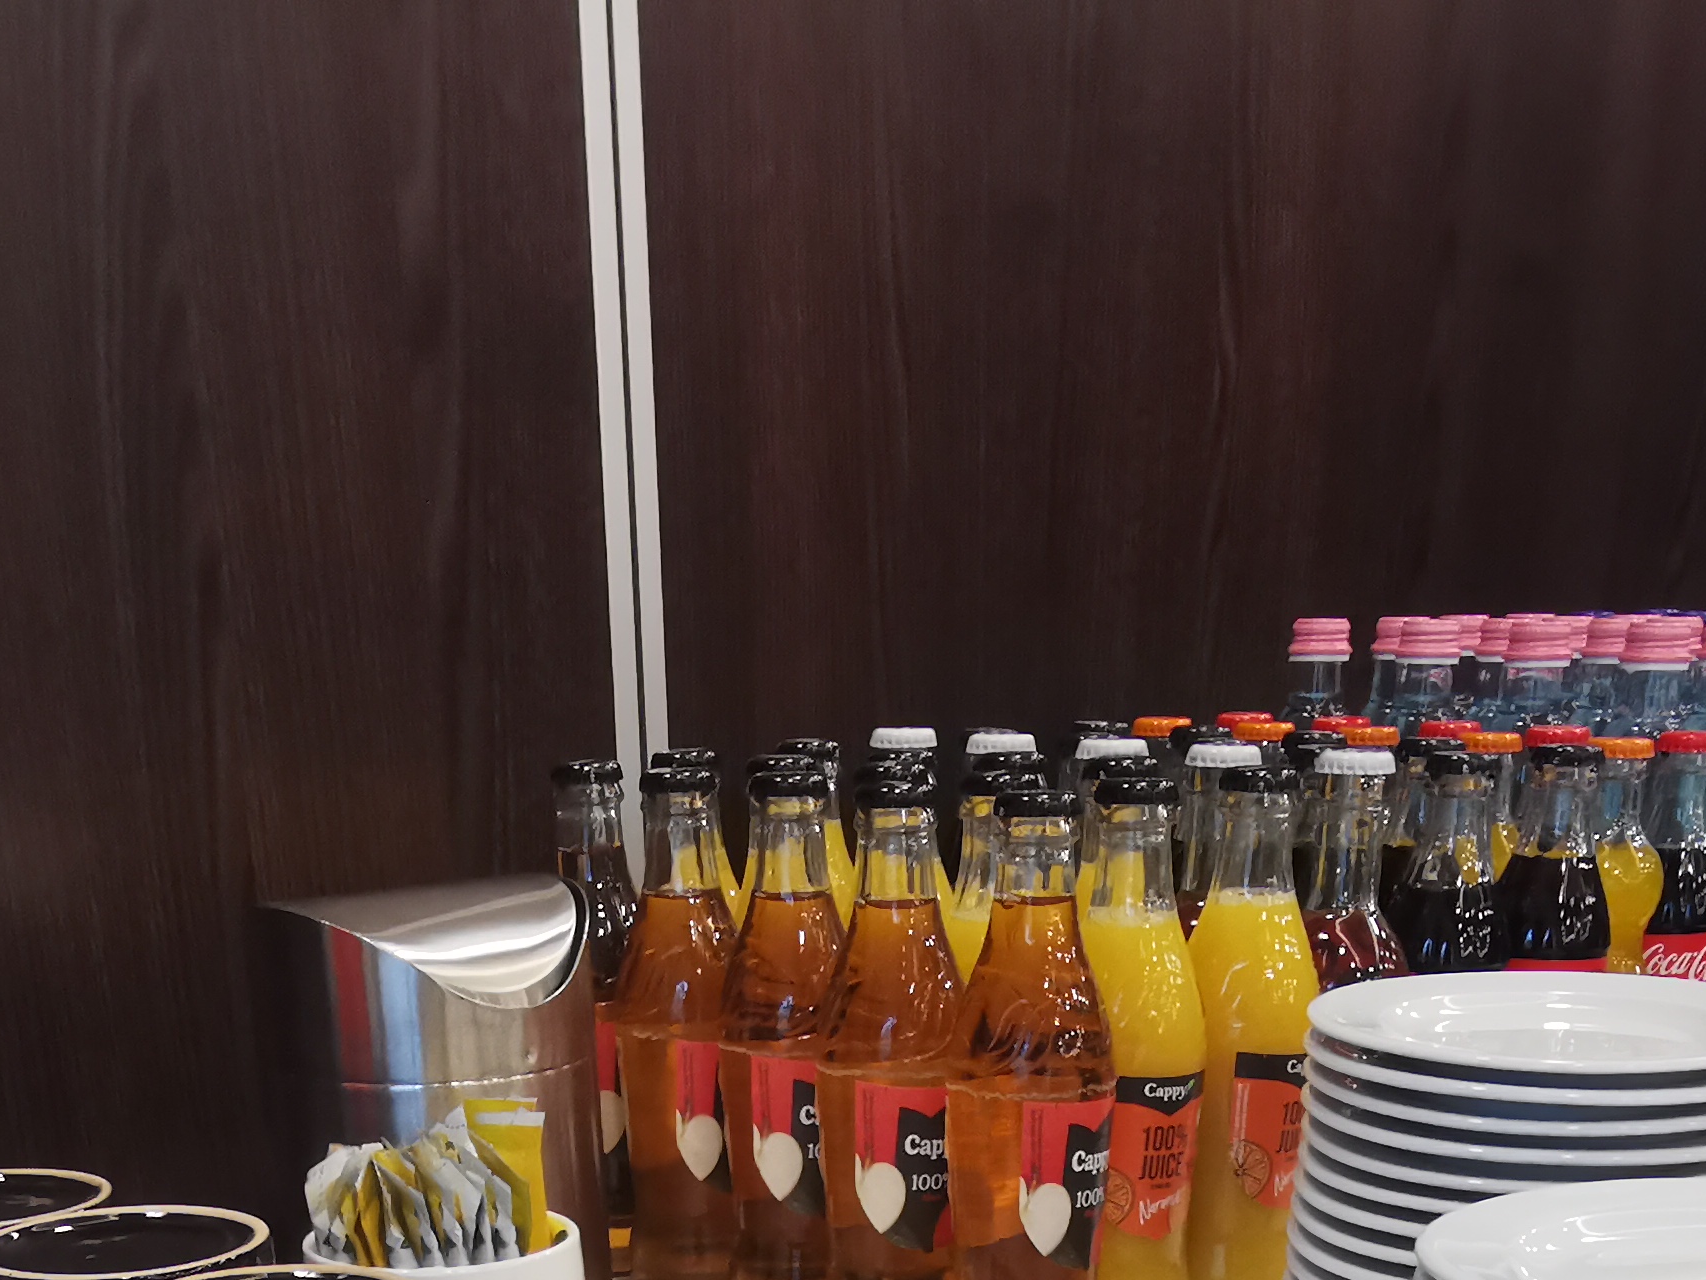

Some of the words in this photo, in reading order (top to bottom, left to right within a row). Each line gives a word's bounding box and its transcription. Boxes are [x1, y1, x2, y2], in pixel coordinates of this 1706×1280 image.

[1144, 1082, 1188, 1101] Cappy
[1143, 1124, 1188, 1151] 100%
[1138, 1151, 1184, 1180] JUICE
